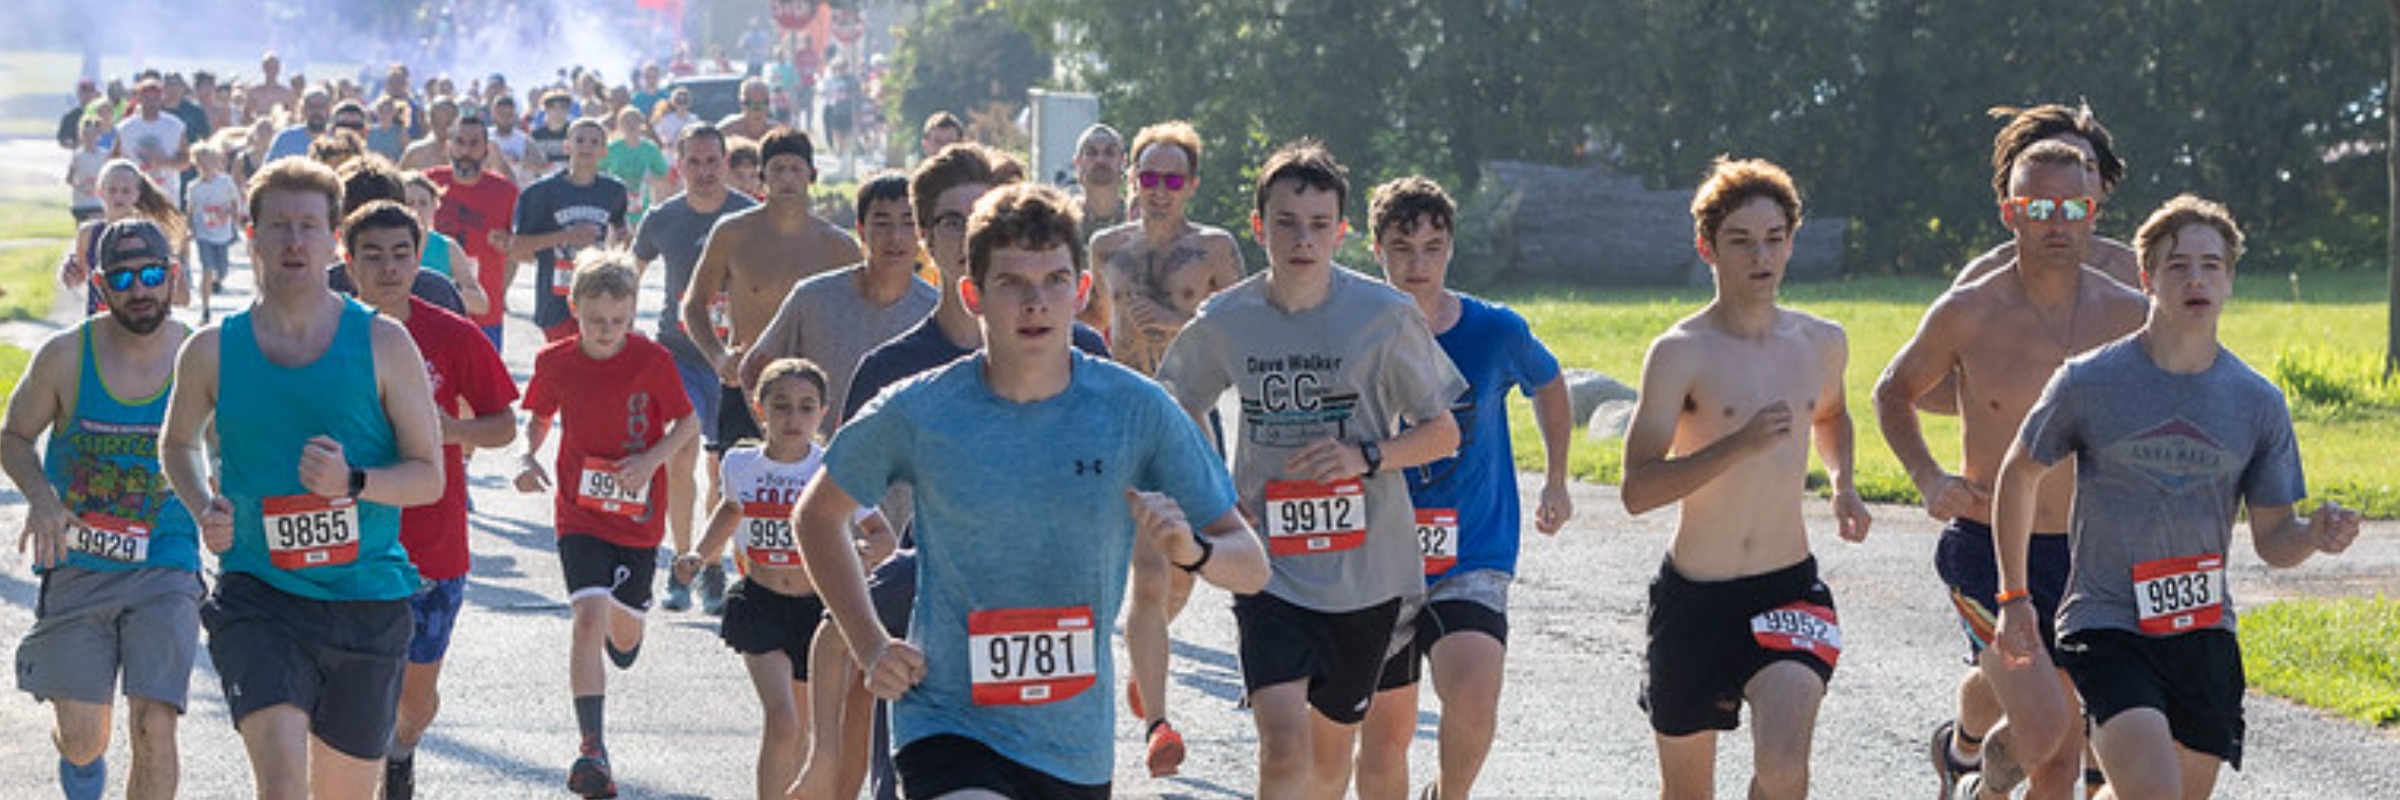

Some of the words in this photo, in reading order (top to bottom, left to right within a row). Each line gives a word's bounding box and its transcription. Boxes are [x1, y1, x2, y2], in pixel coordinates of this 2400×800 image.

[1246, 355, 1283, 374] Dave
[1287, 353, 1342, 373] Walker
[588, 472, 638, 499] 99
[278, 510, 350, 548] 9855
[1281, 498, 1352, 534] 9912
[78, 527, 137, 561] 9929
[750, 519, 793, 548] 993
[1417, 526, 1448, 556] 32
[2148, 573, 2210, 613] 9933
[989, 634, 1074, 679] 9781
